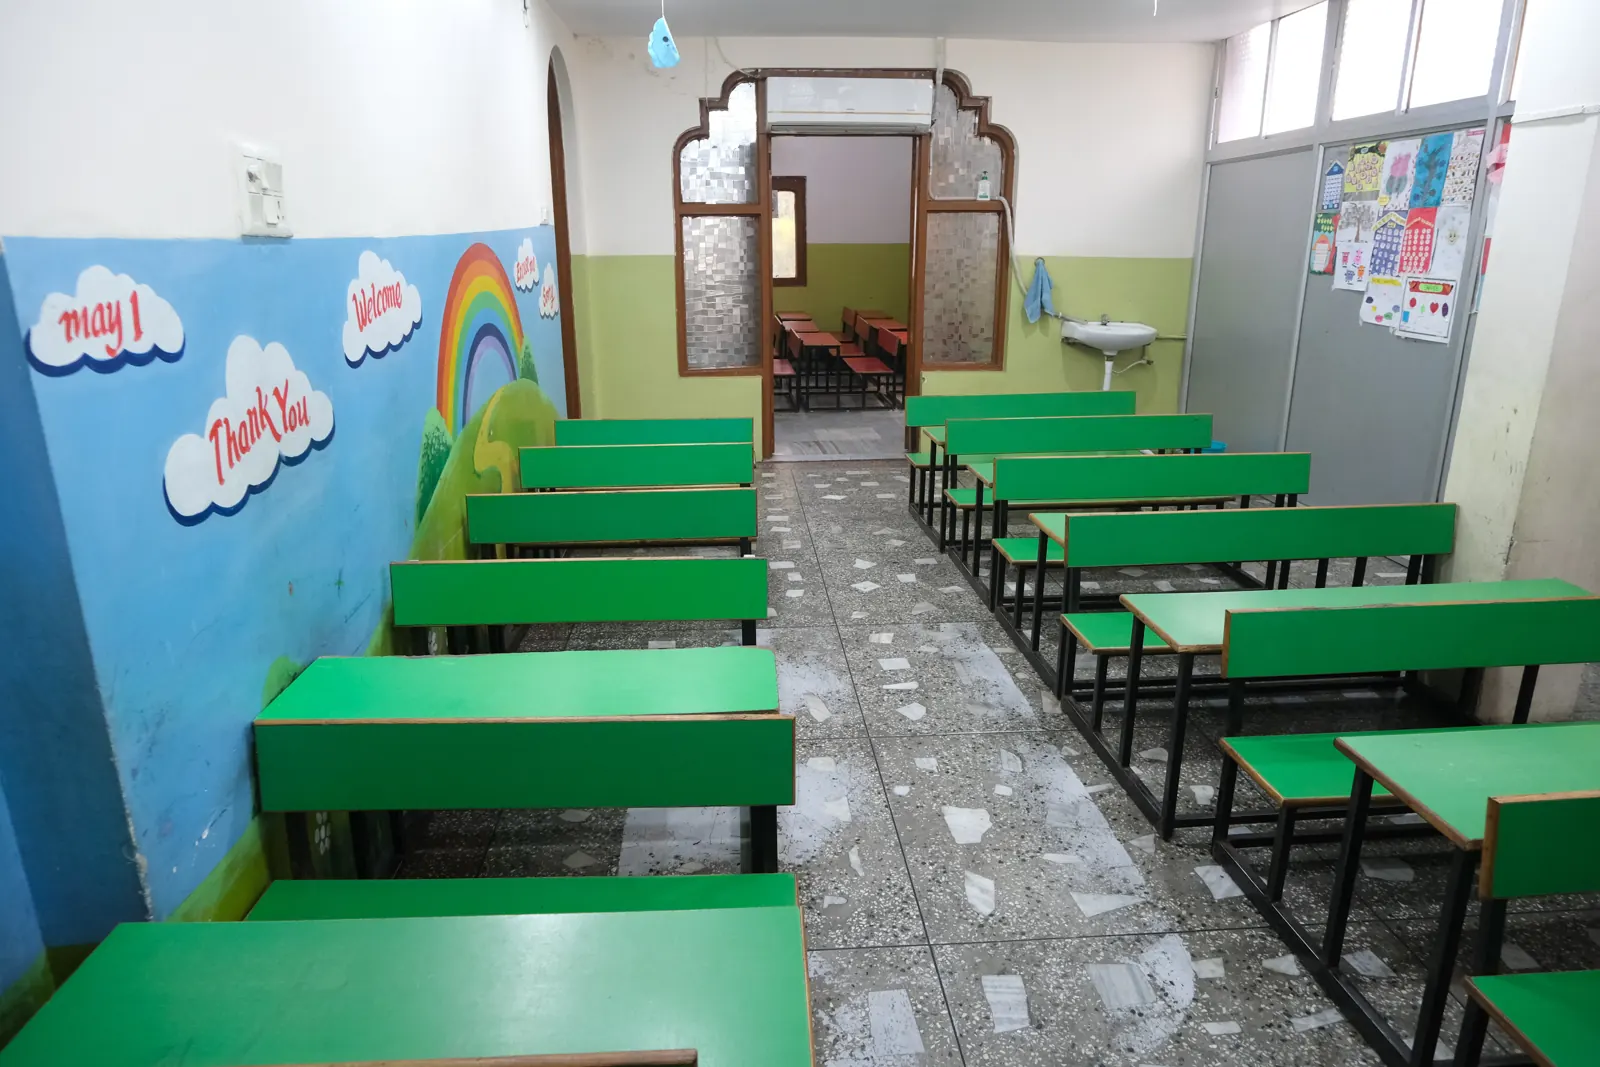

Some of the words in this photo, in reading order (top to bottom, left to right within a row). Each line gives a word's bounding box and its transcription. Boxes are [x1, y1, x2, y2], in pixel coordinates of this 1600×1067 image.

[352, 281, 403, 333] Welcome
[208, 386, 282, 486] Thank
[272, 379, 311, 435] You
